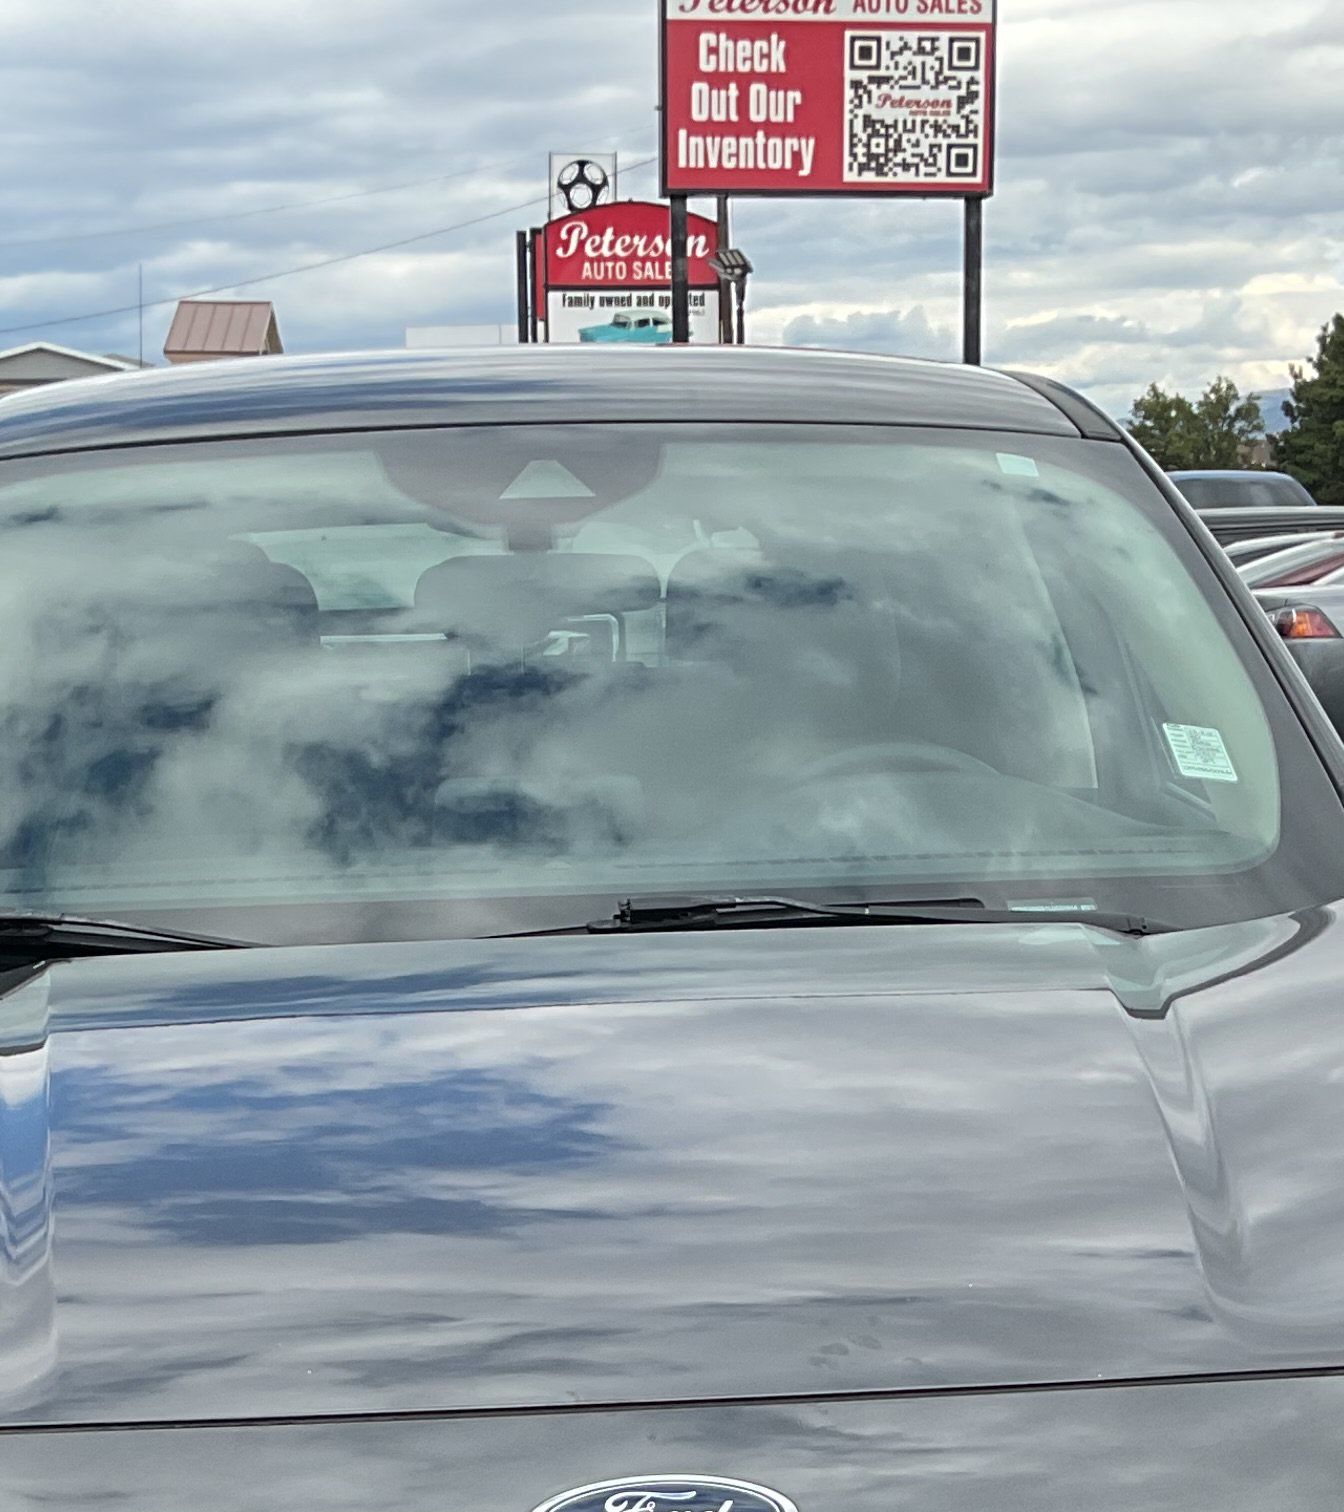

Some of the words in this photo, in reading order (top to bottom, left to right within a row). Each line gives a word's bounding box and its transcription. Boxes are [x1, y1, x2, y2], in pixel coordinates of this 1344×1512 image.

[699, 31, 786, 73] Check
[691, 81, 739, 122] Out
[749, 82, 802, 123] Our
[876, 93, 953, 109] Peterson
[678, 128, 815, 176] Inventory
[556, 221, 710, 258] Petersn
[582, 261, 627, 280] AUTO
[633, 261, 674, 280] SALE
[599, 294, 632, 307] owned
[636, 294, 654, 307] and
[658, 293, 705, 309] opted
